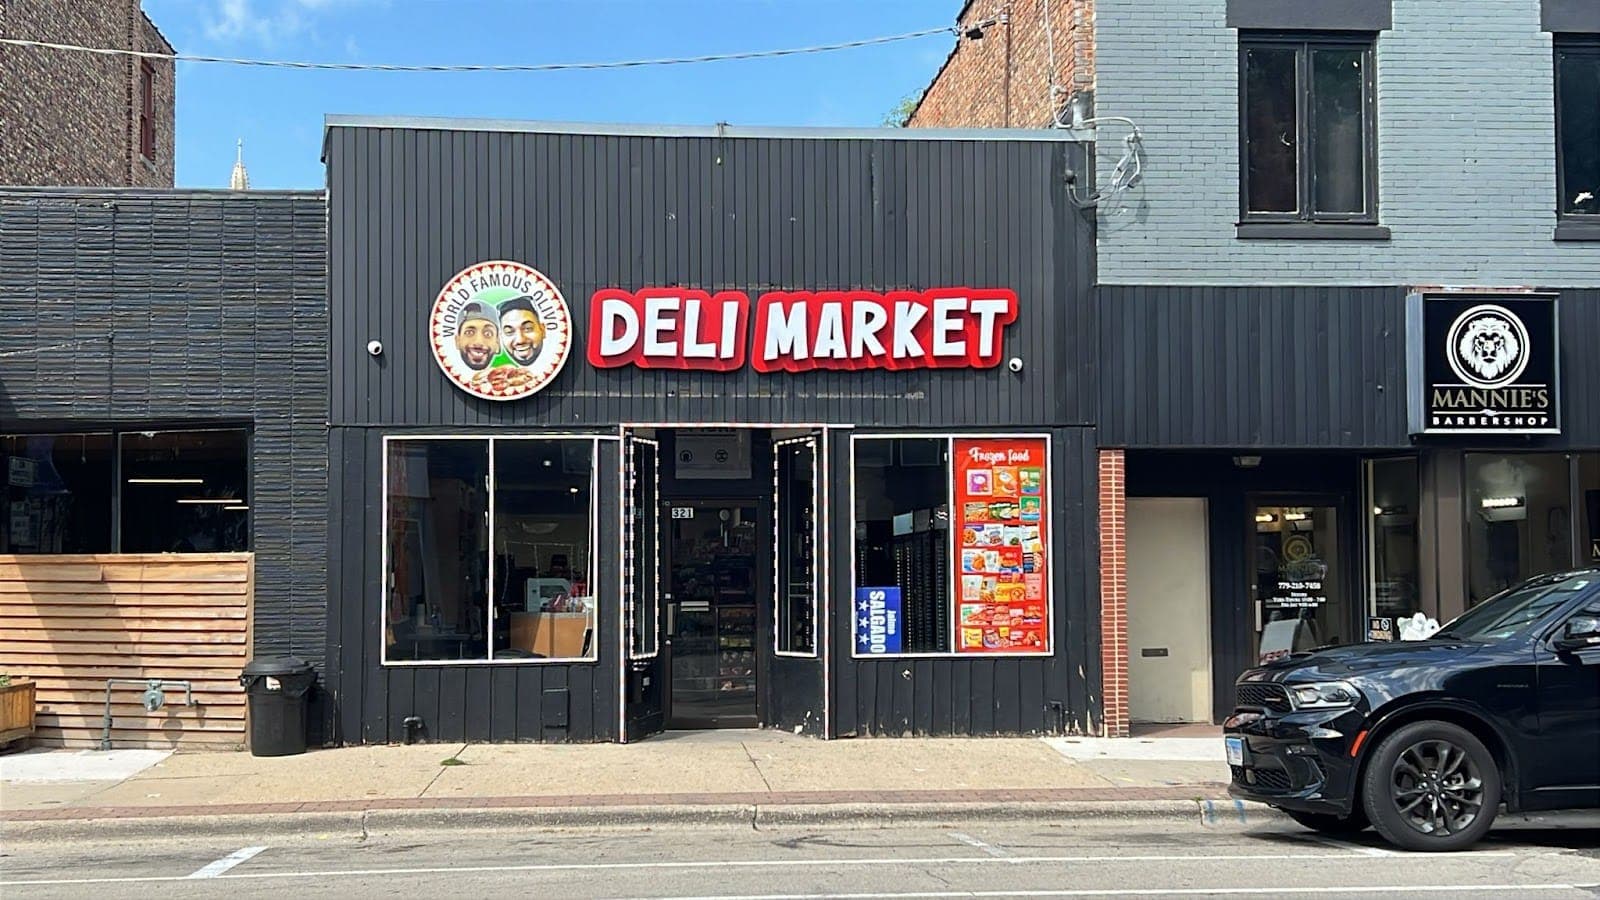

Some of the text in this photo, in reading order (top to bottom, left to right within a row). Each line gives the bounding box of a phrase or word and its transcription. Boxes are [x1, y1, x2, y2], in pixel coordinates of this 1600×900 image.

[443, 273, 558, 338] WORLD FAMOUS OLIVO
[600, 297, 1009, 361] DELI MARKET
[1432, 389, 1548, 408] MANNIE'S
[1432, 417, 1548, 425] BARBERSHOP
[968, 447, 1030, 465] Frozen food
[672, 508, 692, 518] 321
[869, 590, 886, 653] SALGADO
